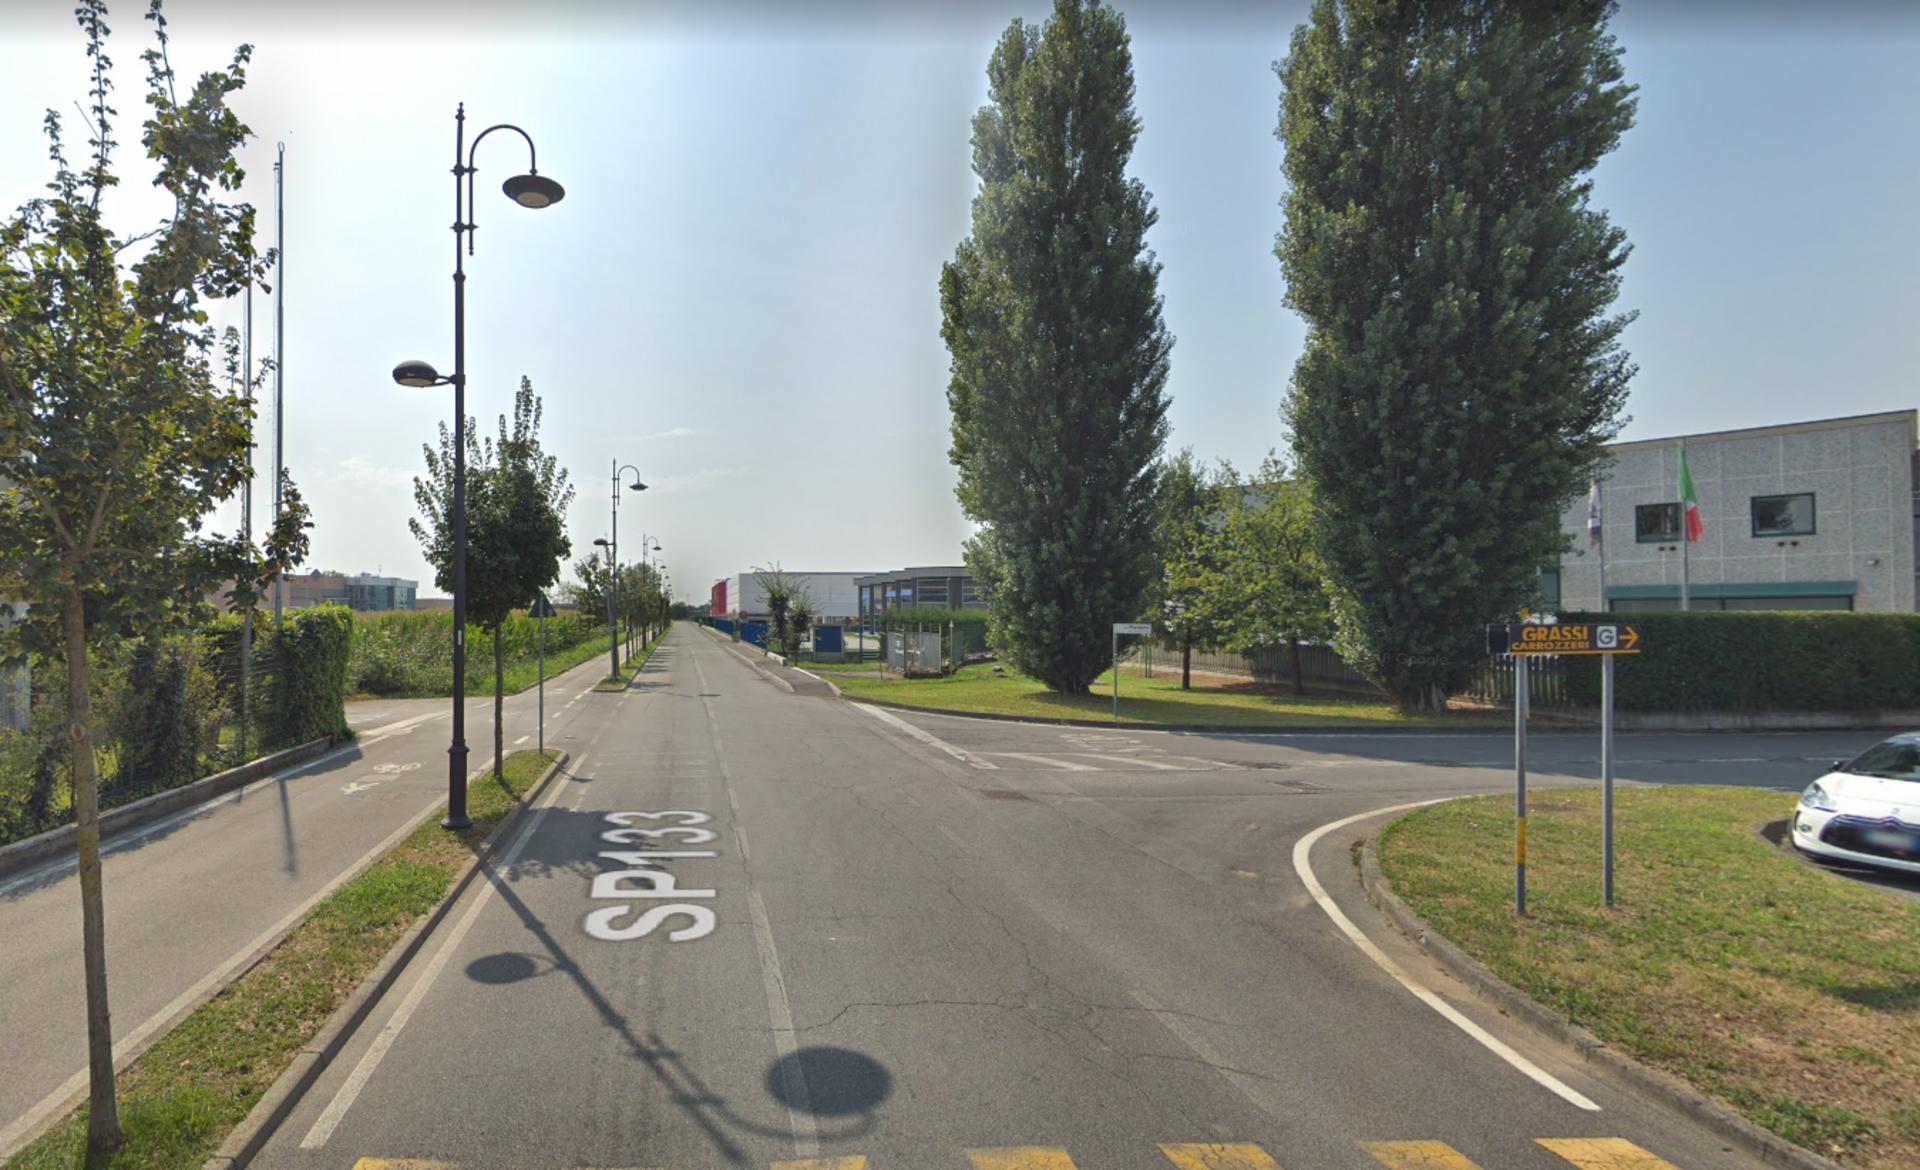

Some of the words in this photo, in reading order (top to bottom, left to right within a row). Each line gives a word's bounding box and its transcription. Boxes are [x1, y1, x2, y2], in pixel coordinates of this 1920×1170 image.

[1522, 626, 1588, 641] GRASSI
[1598, 628, 1615, 645] G
[1511, 641, 1590, 650] CARROZZERI
[584, 811, 718, 942] SP133
